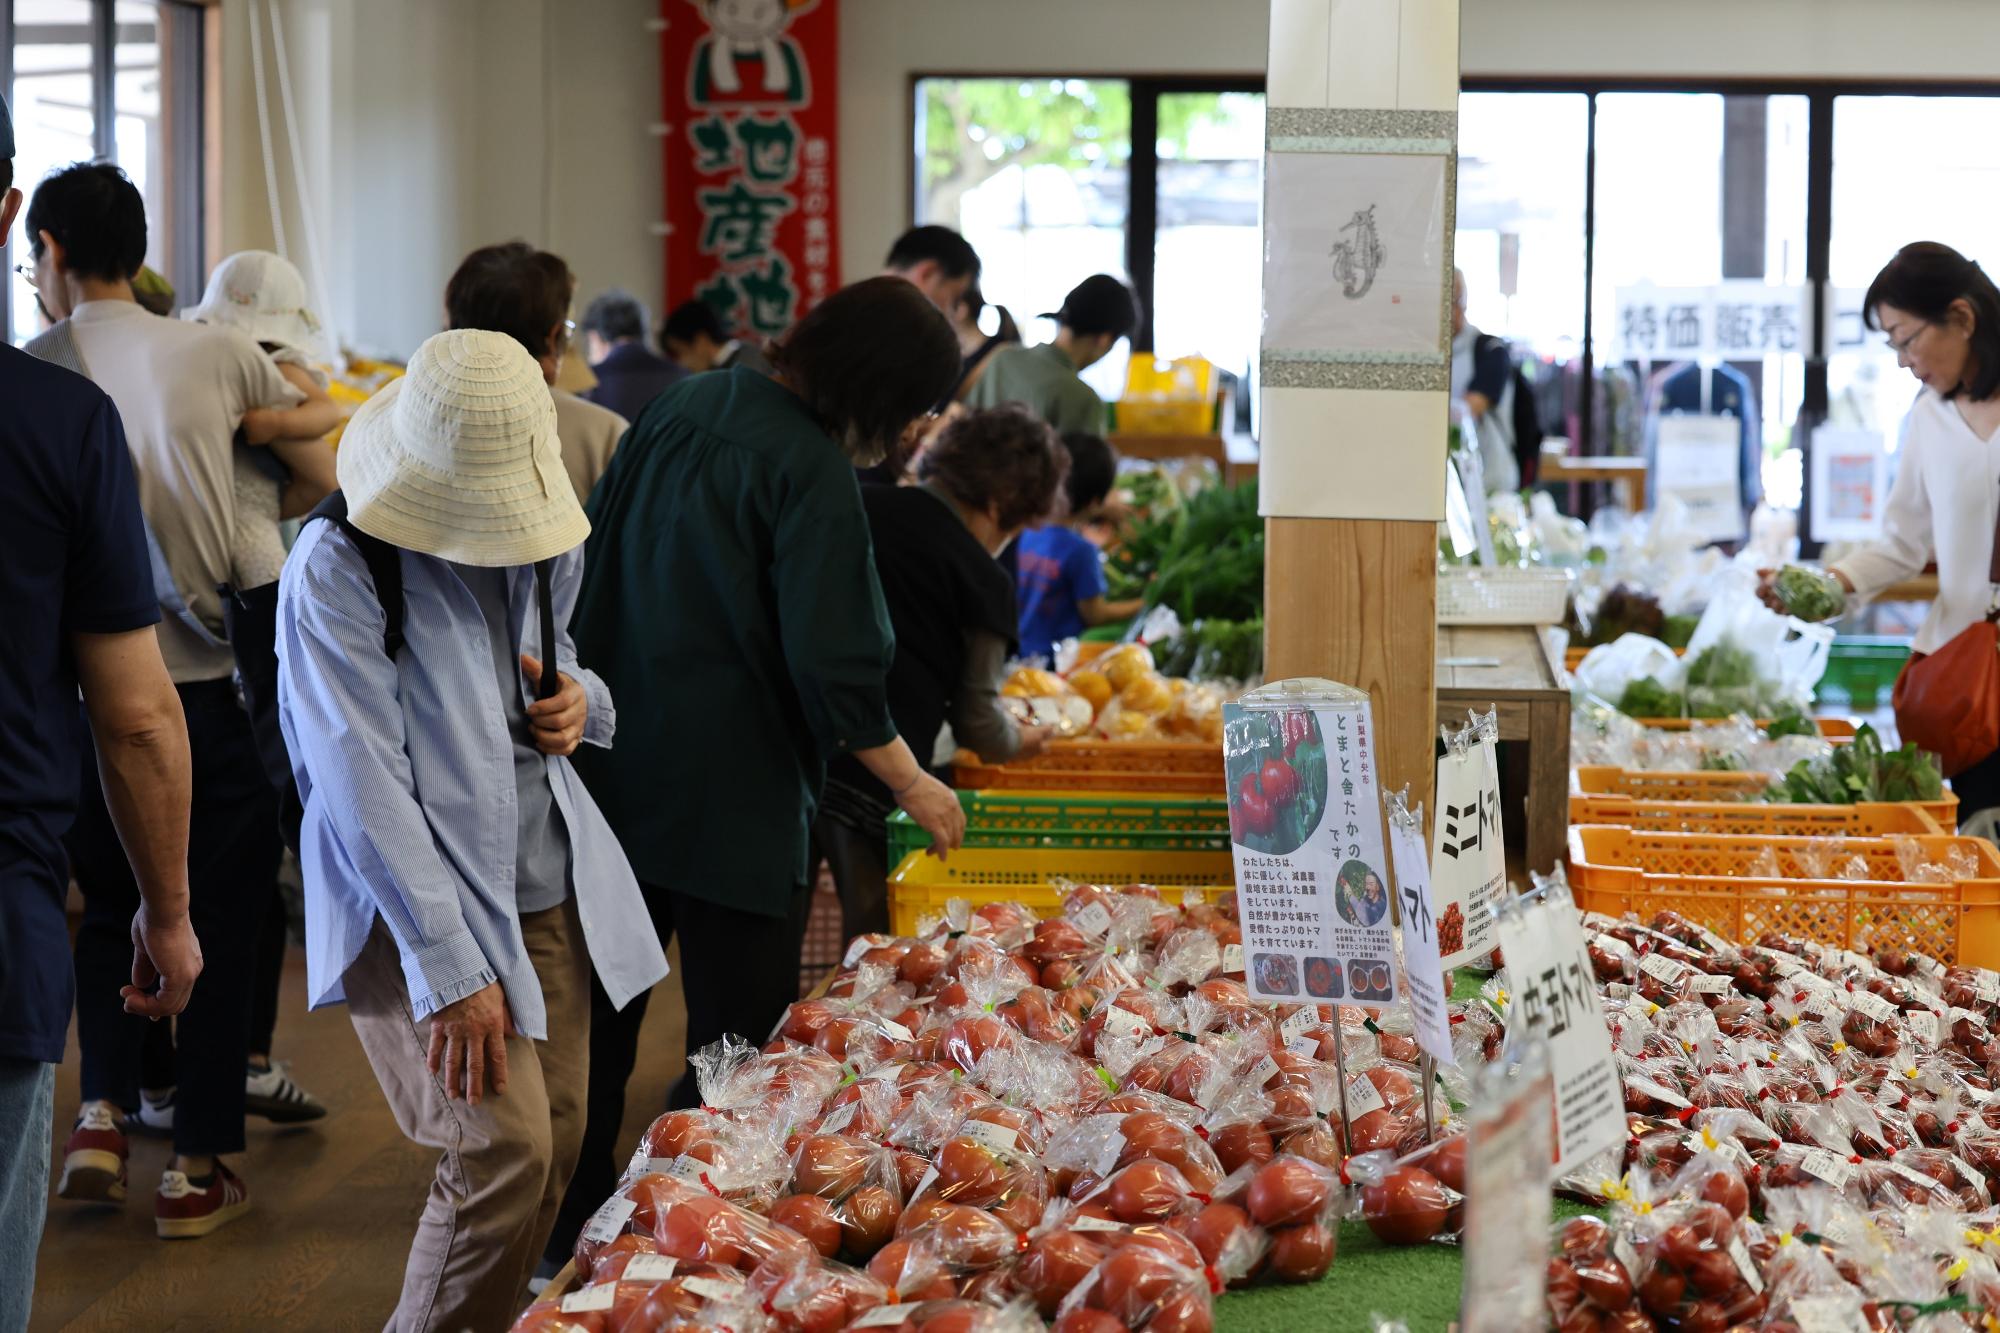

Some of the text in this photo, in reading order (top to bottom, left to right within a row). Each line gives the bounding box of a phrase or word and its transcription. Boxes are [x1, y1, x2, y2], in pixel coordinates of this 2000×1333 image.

[1356, 713, 1370, 784] 山梨県中央市
[1337, 713, 1361, 858] とまと舎たかの
[1442, 777, 1500, 860] ミニトマト
[1242, 857, 1294, 868] わたしたちは、
[1243, 871, 1316, 881] 体に優しく、減農薬
[1245, 884, 1317, 895] 栽培を追求した農業
[1246, 897, 1298, 908] をしています。
[1248, 911, 1319, 922] 自然が豊かな場所で
[1249, 924, 1320, 935] 愛情たっぷりのトマ
[1252, 937, 1319, 949] トを育てています。
